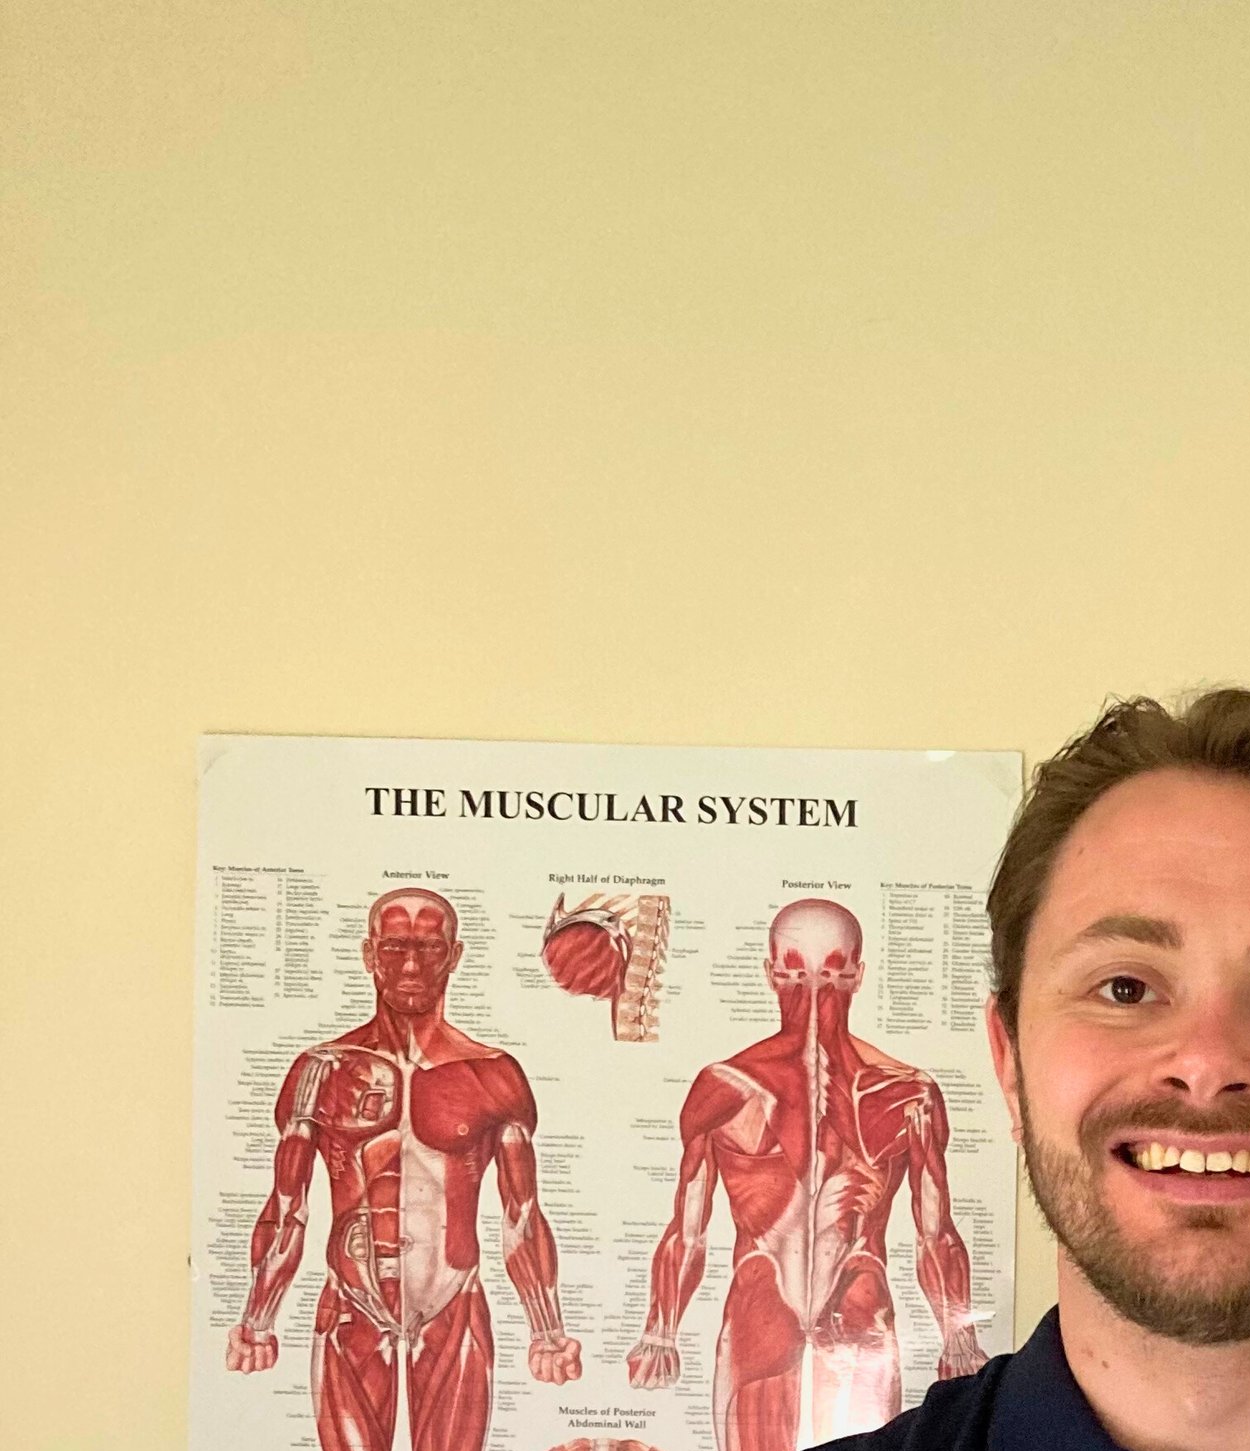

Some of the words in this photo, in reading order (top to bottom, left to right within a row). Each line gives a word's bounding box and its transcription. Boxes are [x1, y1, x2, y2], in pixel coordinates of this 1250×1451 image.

[365, 786, 447, 817] THE
[458, 789, 687, 824] MUSCULAR
[697, 795, 859, 828] SYSTEM
[382, 870, 422, 880] Anterior
[425, 870, 450, 880] View
[548, 873, 574, 884] Right
[577, 873, 598, 883] Half
[600, 875, 610, 884] of
[613, 875, 666, 887] Diaphragm
[782, 879, 824, 889] Posterior
[827, 880, 852, 890] View
[558, 1406, 598, 1416] Muscles
[600, 1407, 610, 1416] of
[613, 1407, 656, 1417] Posterior
[568, 1419, 622, 1429] Abdominal
[625, 1420, 647, 1429] Wall
